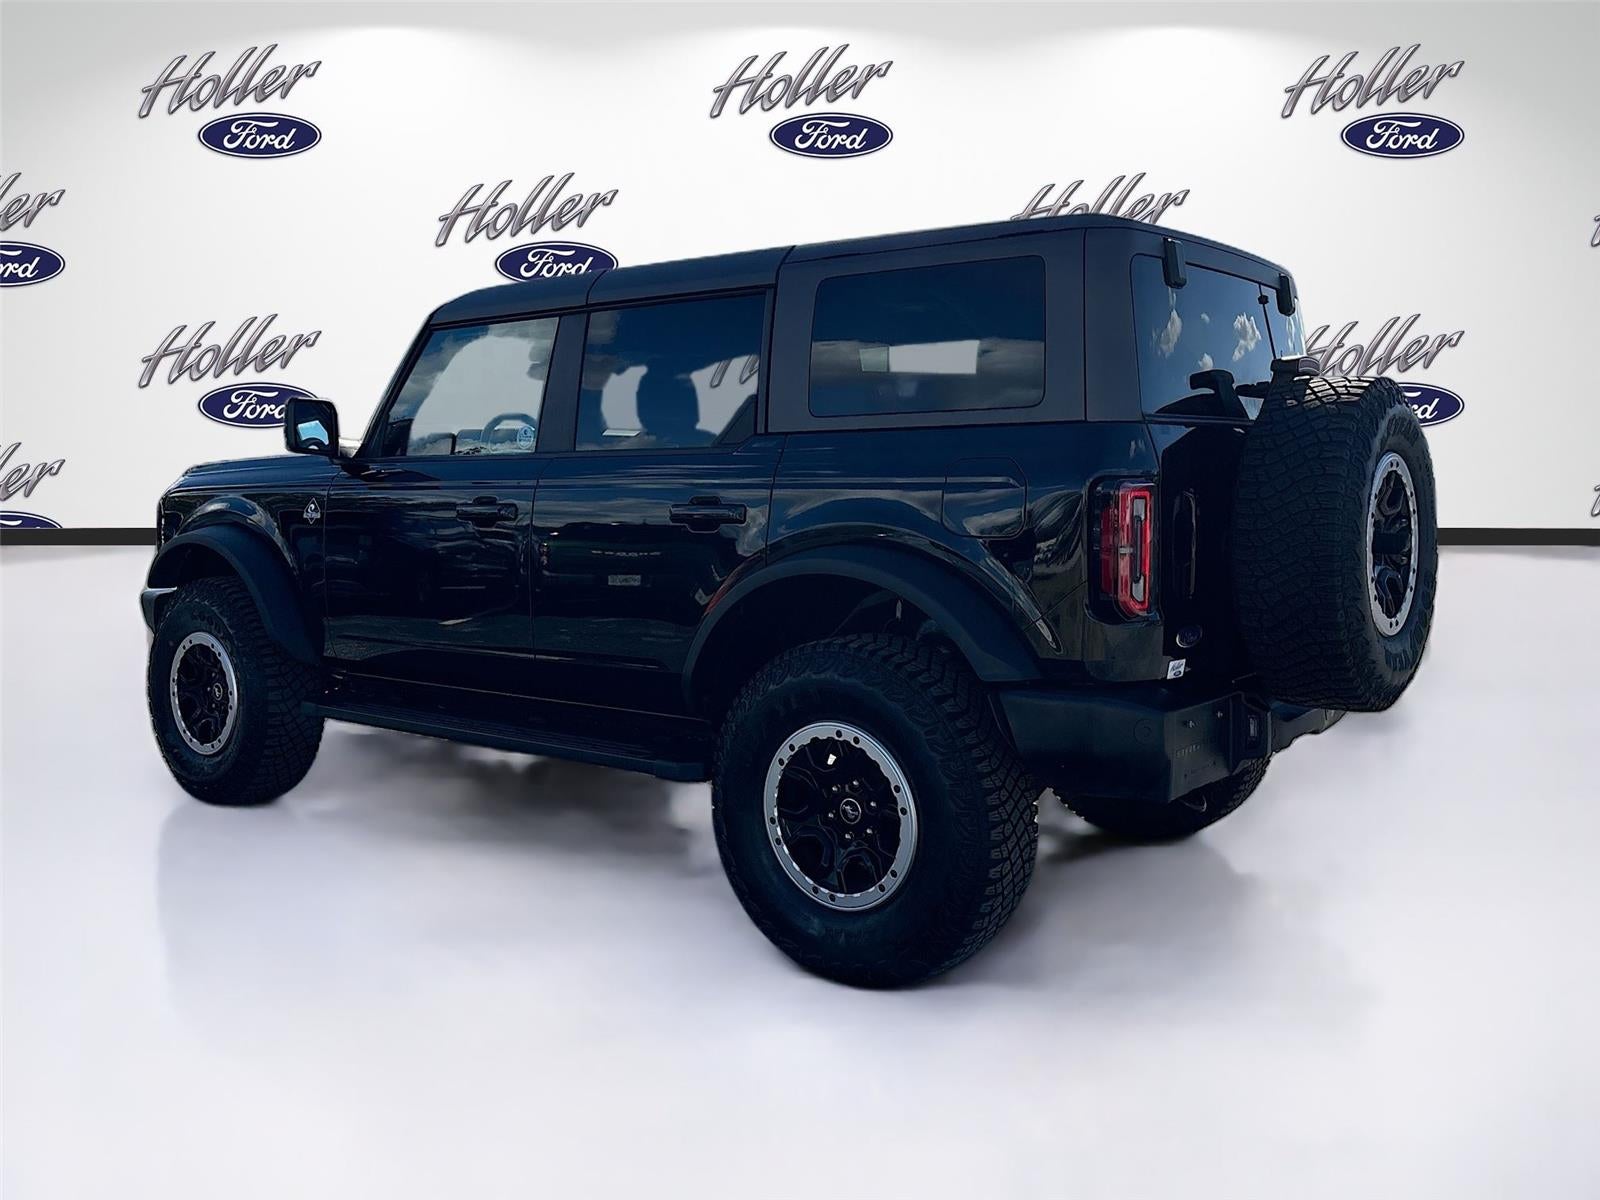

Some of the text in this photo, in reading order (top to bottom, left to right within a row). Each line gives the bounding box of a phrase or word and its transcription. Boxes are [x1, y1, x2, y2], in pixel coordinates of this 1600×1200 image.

[138, 43, 322, 119] Holler
[709, 43, 894, 119] Holler
[1281, 43, 1465, 119] Holler
[223, 119, 297, 150] Ford
[794, 119, 868, 150] Ford
[1365, 119, 1440, 150] Ford
[435, 172, 619, 248] Holler
[519, 248, 594, 278] Ford
[138, 313, 322, 389] Holler
